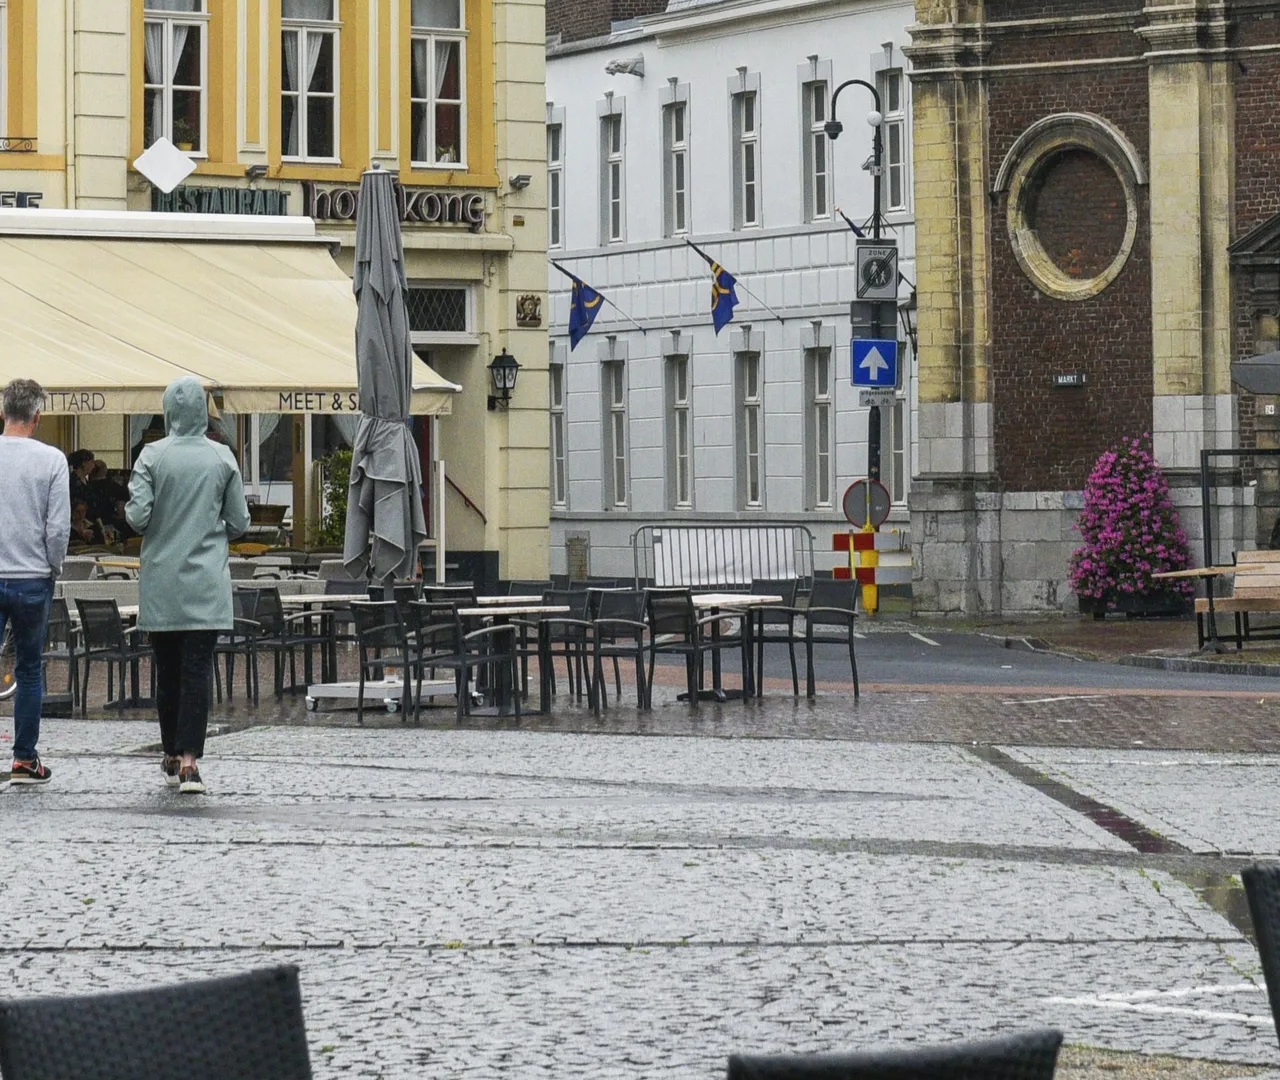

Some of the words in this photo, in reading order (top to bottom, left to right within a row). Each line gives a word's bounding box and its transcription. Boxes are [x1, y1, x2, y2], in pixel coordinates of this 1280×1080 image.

[1058, 375, 1077, 383] MARKT
[279, 392, 326, 411] MEET
[331, 392, 343, 411] &
